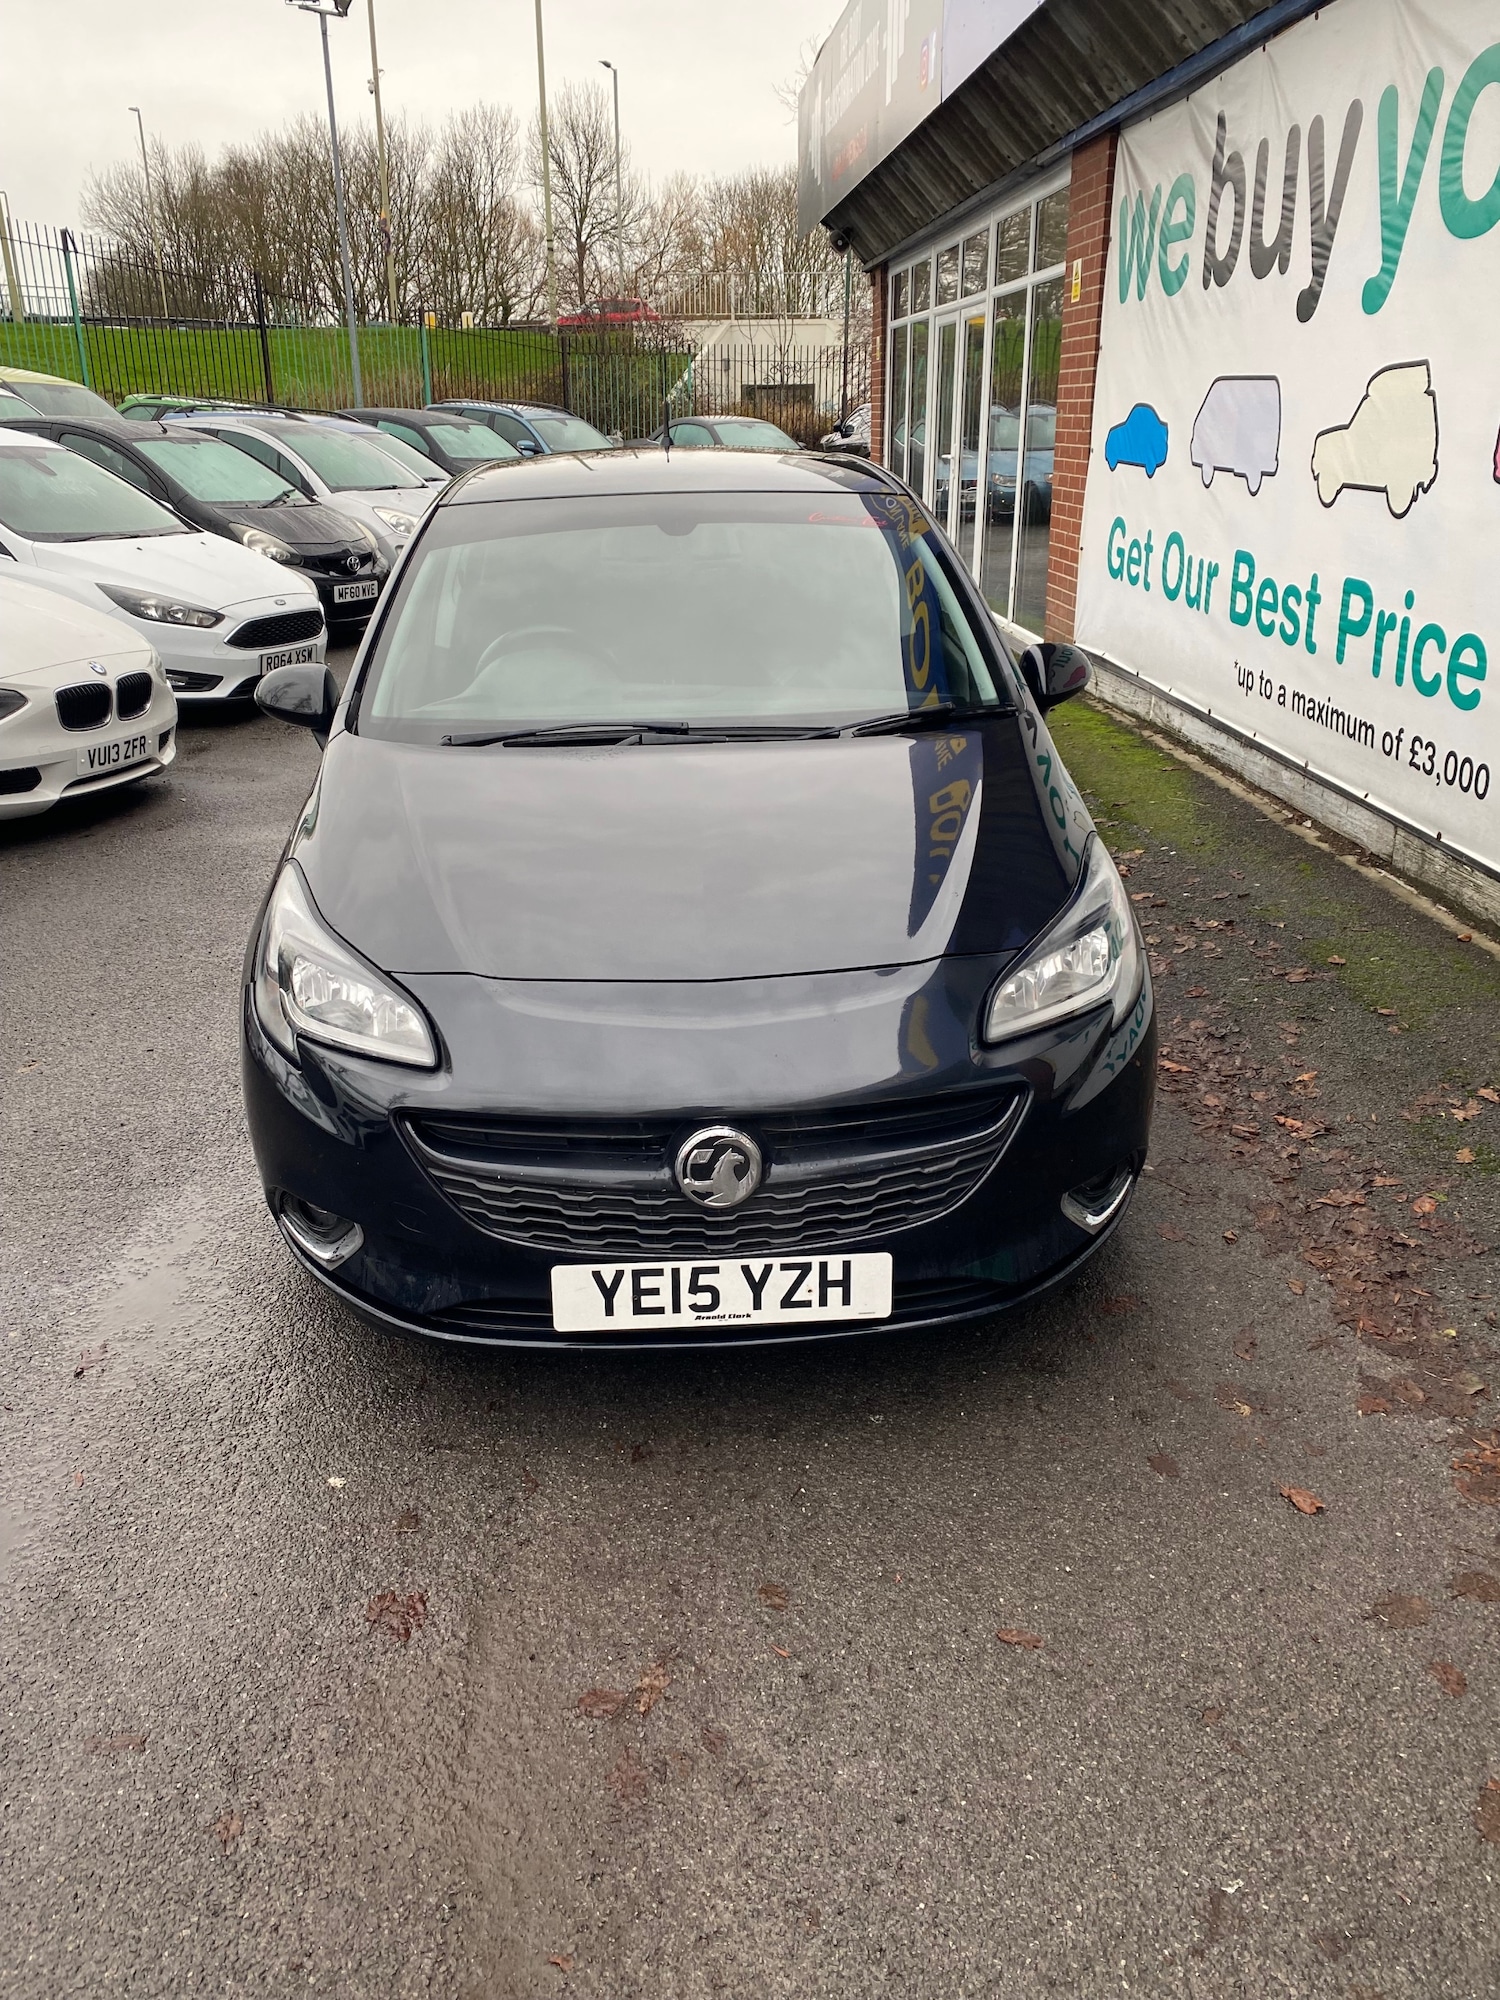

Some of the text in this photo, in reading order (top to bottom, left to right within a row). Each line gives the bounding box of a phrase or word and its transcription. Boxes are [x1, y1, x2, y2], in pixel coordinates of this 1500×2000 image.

[1118, 172, 1196, 305] we
[1202, 97, 1364, 323] buy
[338, 586, 360, 600] MF60
[1107, 516, 1488, 711] Get Our Best Price
[87, 735, 147, 769] VU13 ZFR
[1259, 670, 1273, 700] to
[1277, 684, 1287, 707] a
[1292, 689, 1375, 749] maximum
[1381, 728, 1404, 761] of
[1409, 735, 1490, 800] £3,000
[591, 1260, 851, 1317] YE15 YZH
